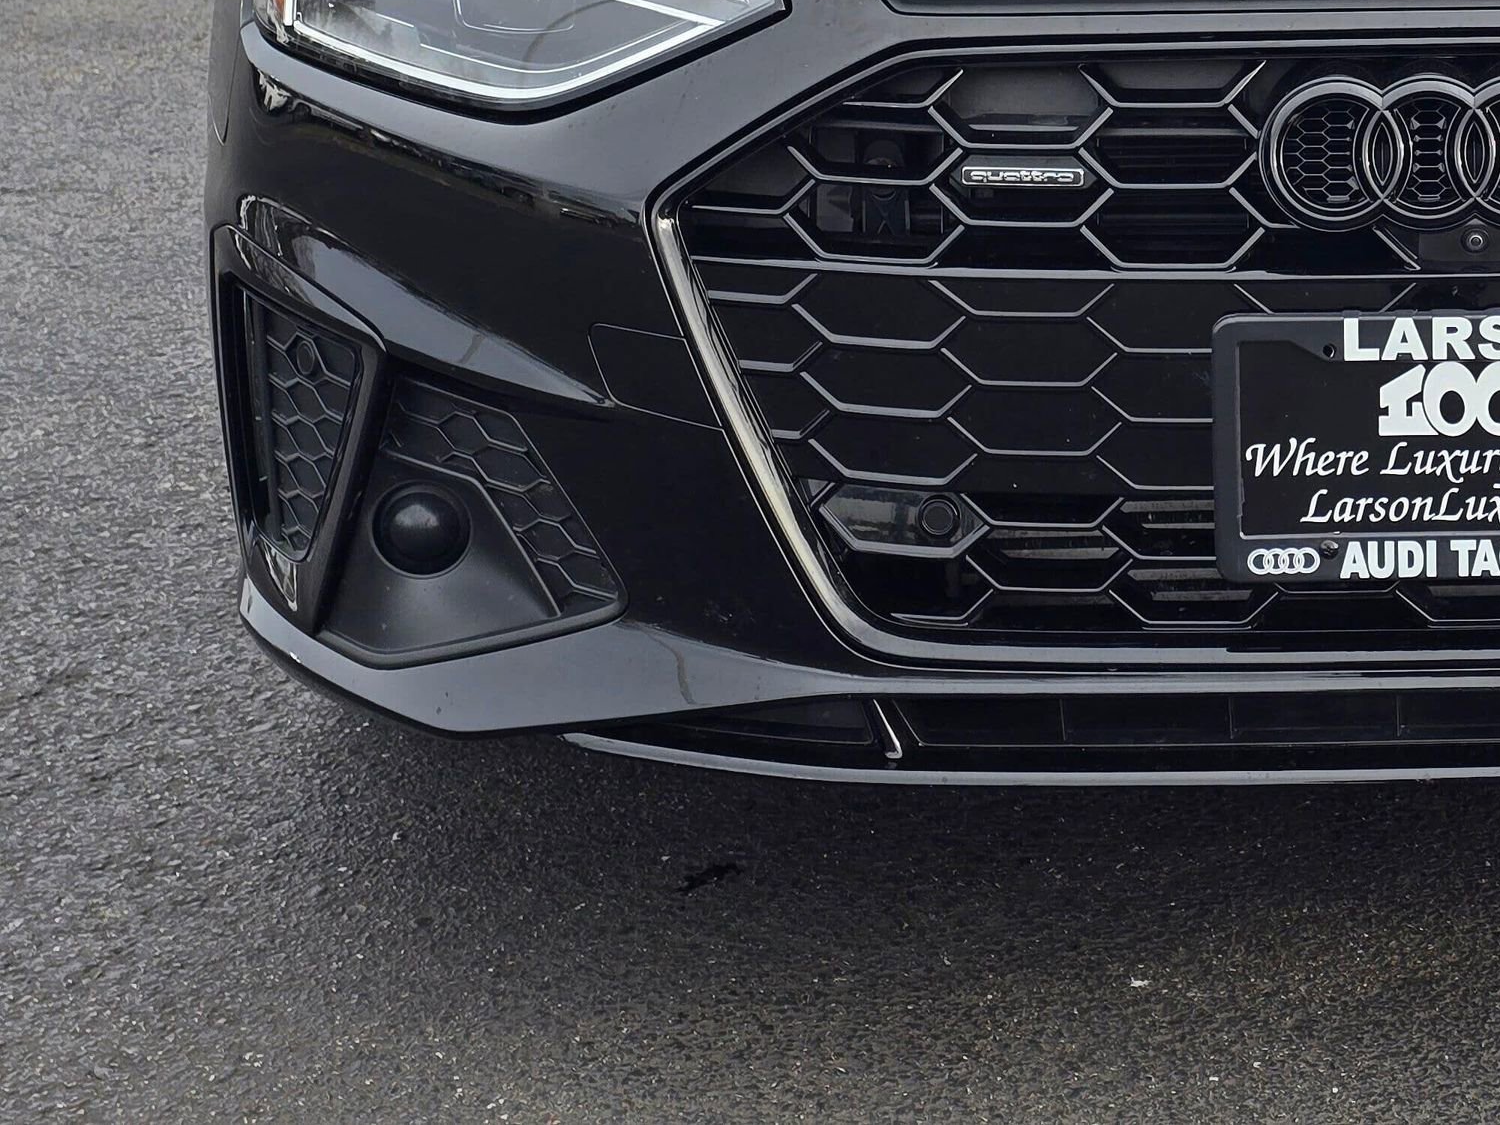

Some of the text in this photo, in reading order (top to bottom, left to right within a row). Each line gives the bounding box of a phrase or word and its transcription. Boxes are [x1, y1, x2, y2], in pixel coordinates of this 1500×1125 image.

[970, 170, 1074, 183] quattro
[1245, 437, 1370, 477] Where
[1339, 539, 1438, 579] AUDI
